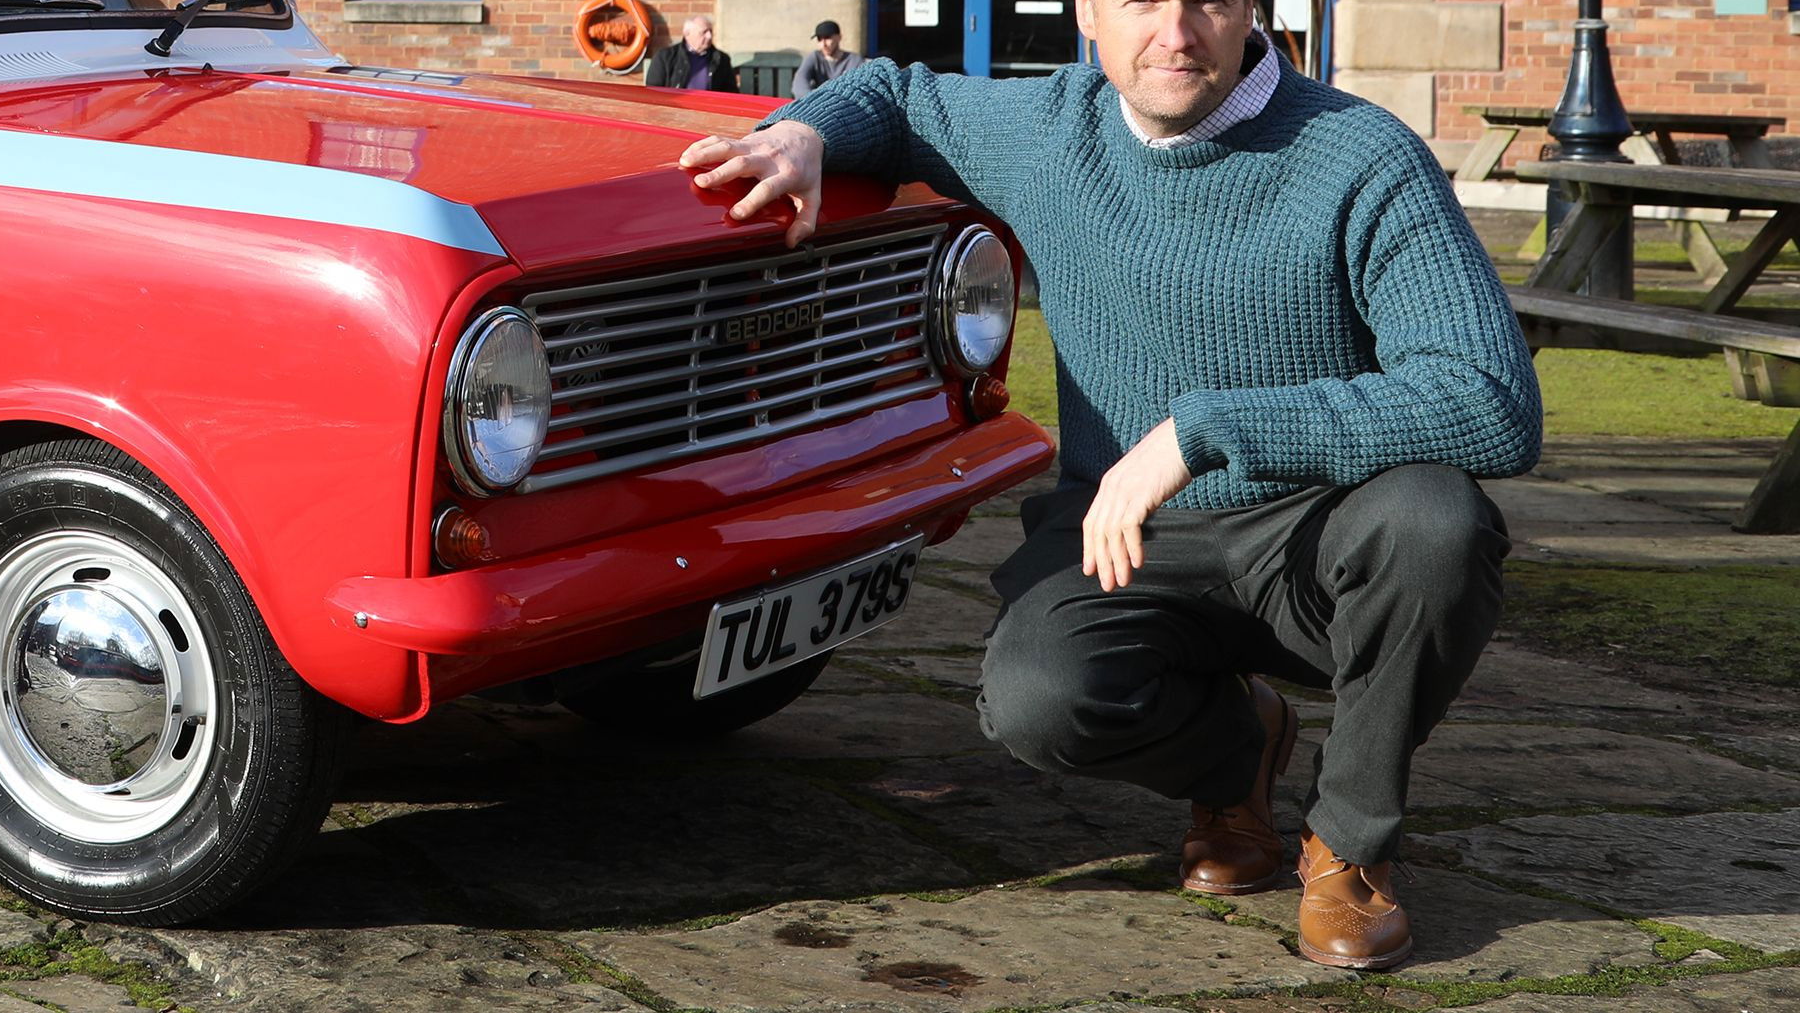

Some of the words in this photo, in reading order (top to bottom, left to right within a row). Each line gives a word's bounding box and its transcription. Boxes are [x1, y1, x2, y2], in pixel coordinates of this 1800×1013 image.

[726, 300, 825, 341] BEDFORD
[717, 594, 797, 683] TUL
[809, 549, 917, 645] 379S
